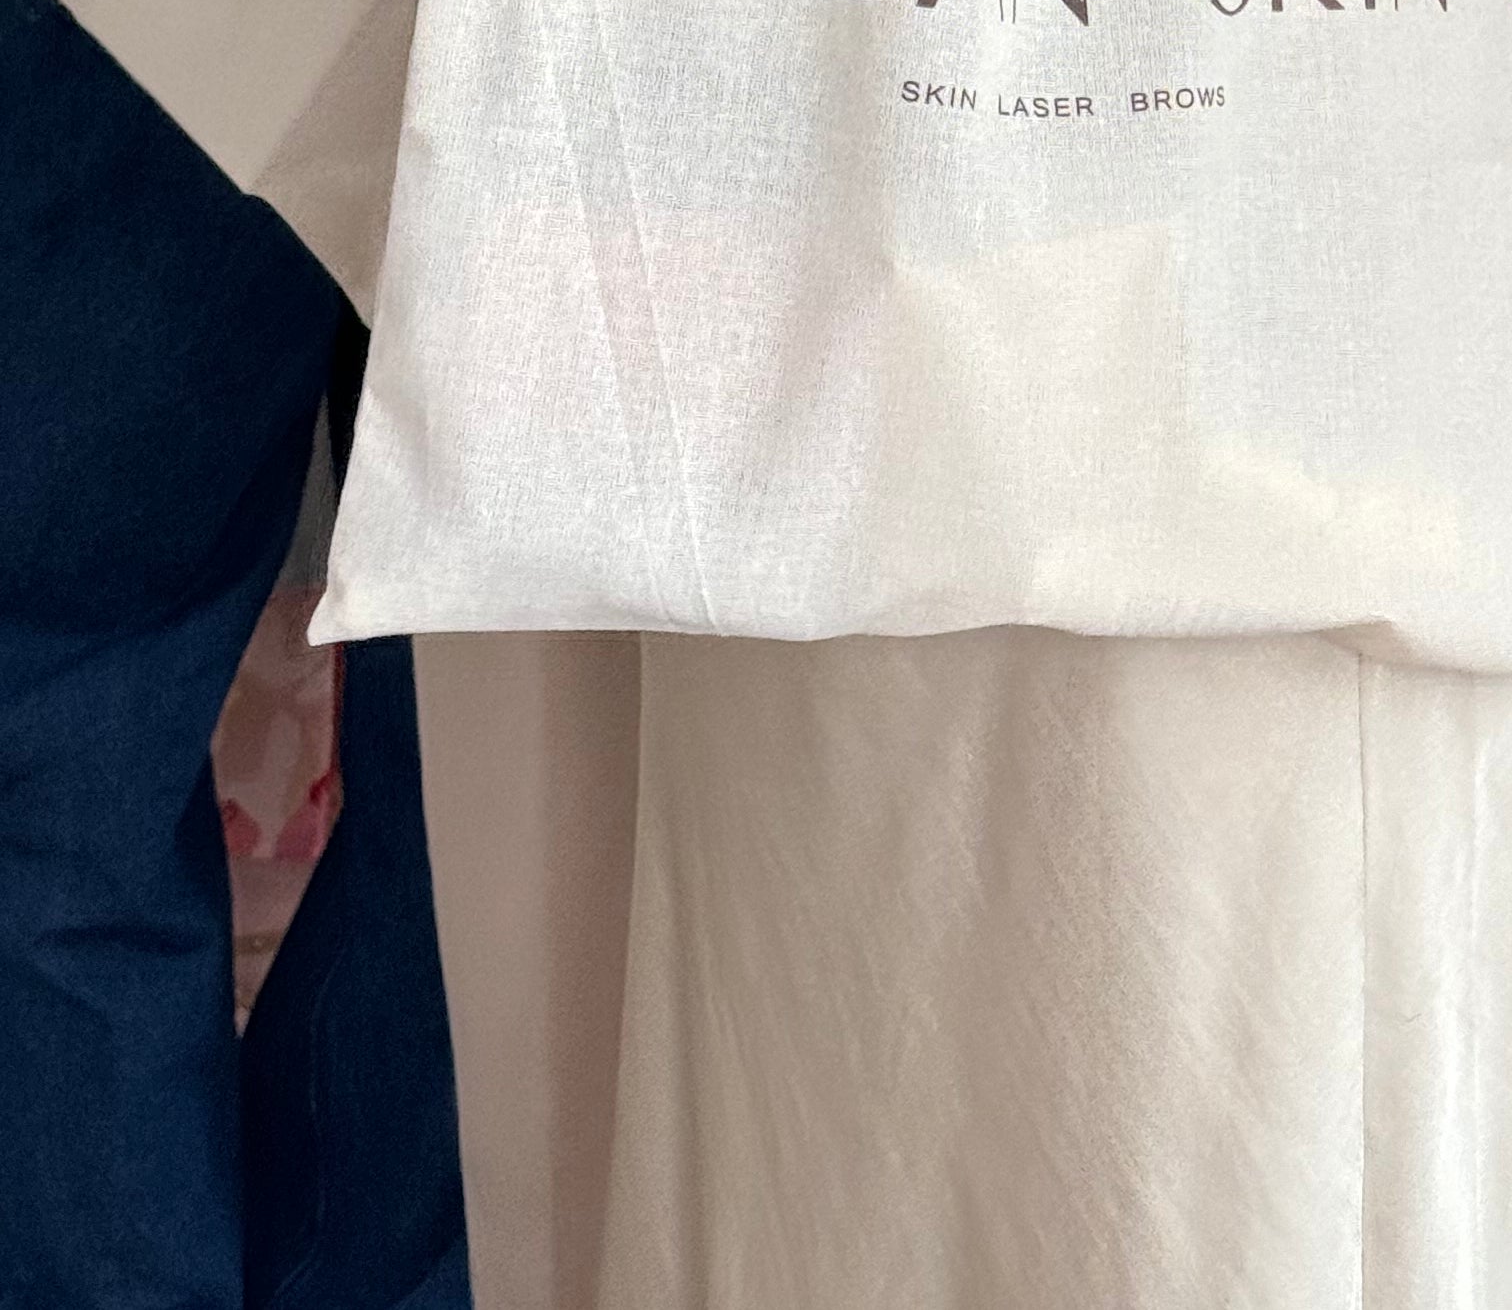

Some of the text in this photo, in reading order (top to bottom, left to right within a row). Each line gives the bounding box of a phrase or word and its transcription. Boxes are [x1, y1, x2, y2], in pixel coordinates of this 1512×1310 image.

[901, 81, 1226, 118] SKIN LASER BROWS
